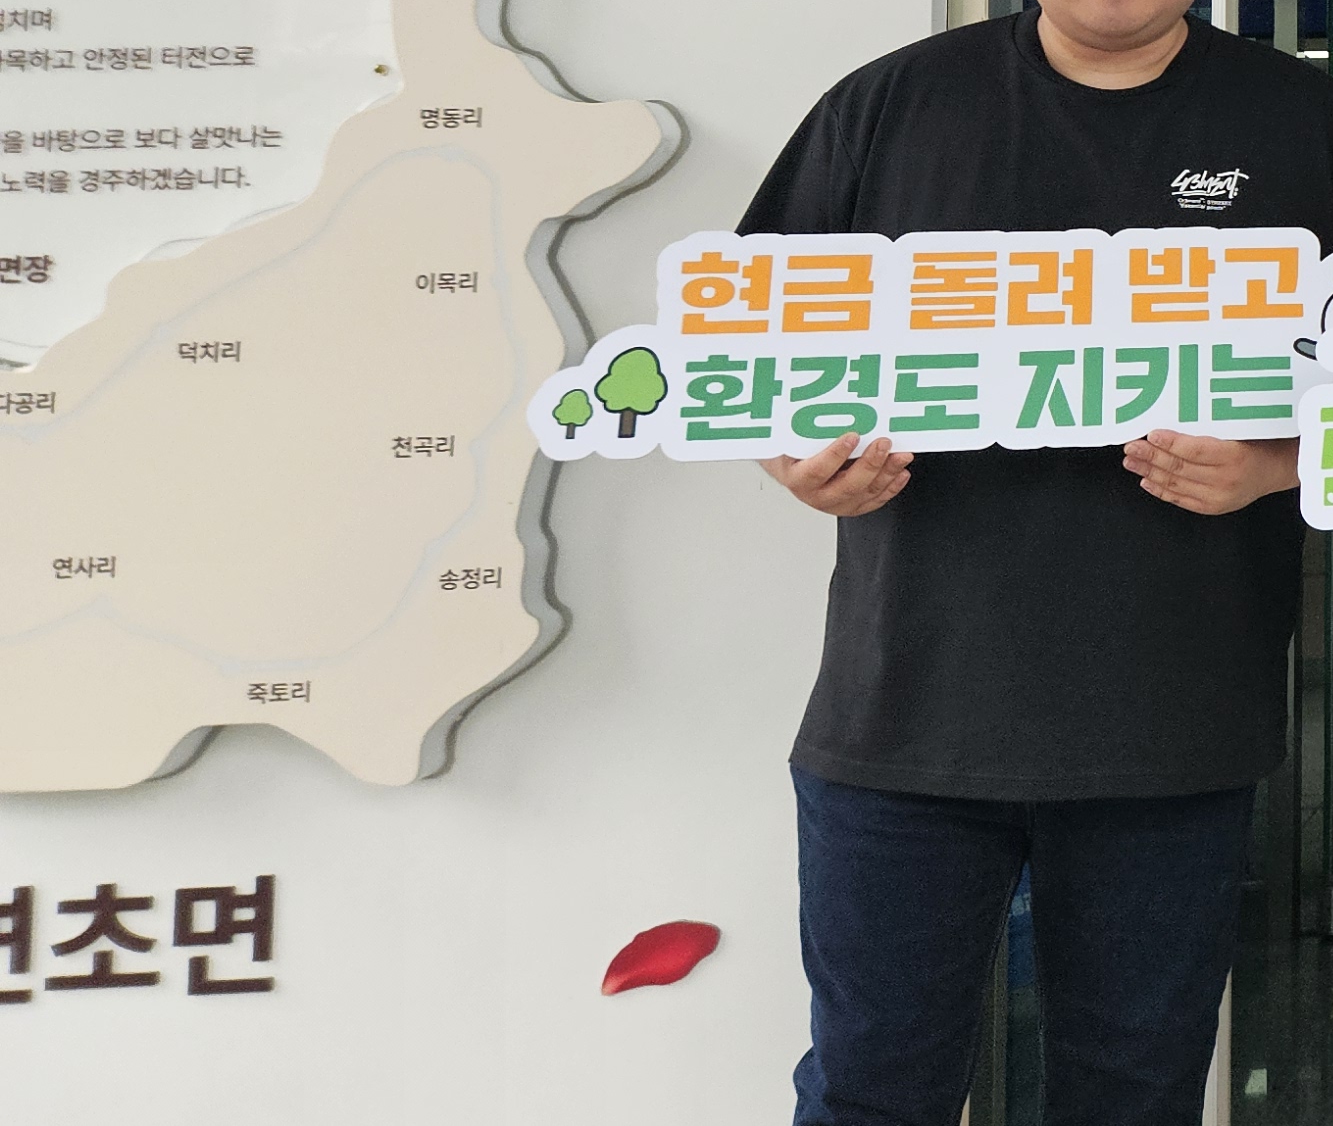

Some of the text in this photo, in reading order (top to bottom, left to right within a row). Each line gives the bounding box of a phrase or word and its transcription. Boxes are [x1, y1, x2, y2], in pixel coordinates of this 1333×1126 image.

[0, 45, 256, 71] 목하고 안정된 터전으로
[419, 106, 484, 130] 명동리
[32, 128, 127, 154] 바탕으로
[134, 126, 182, 150] 보다
[189, 124, 283, 150] 살맛나는
[0, 165, 251, 194] 노력을 경주하겠습니다.
[415, 270, 479, 294] 이목리
[680, 246, 1304, 335] 현금 돌려 받고
[178, 340, 241, 364] 덕치리
[680, 342, 1294, 442] 환경도 지키는
[391, 434, 455, 459] 천곡리
[52, 554, 117, 580] 연사리
[438, 565, 503, 592] 송정리
[247, 679, 312, 705] 죽토리
